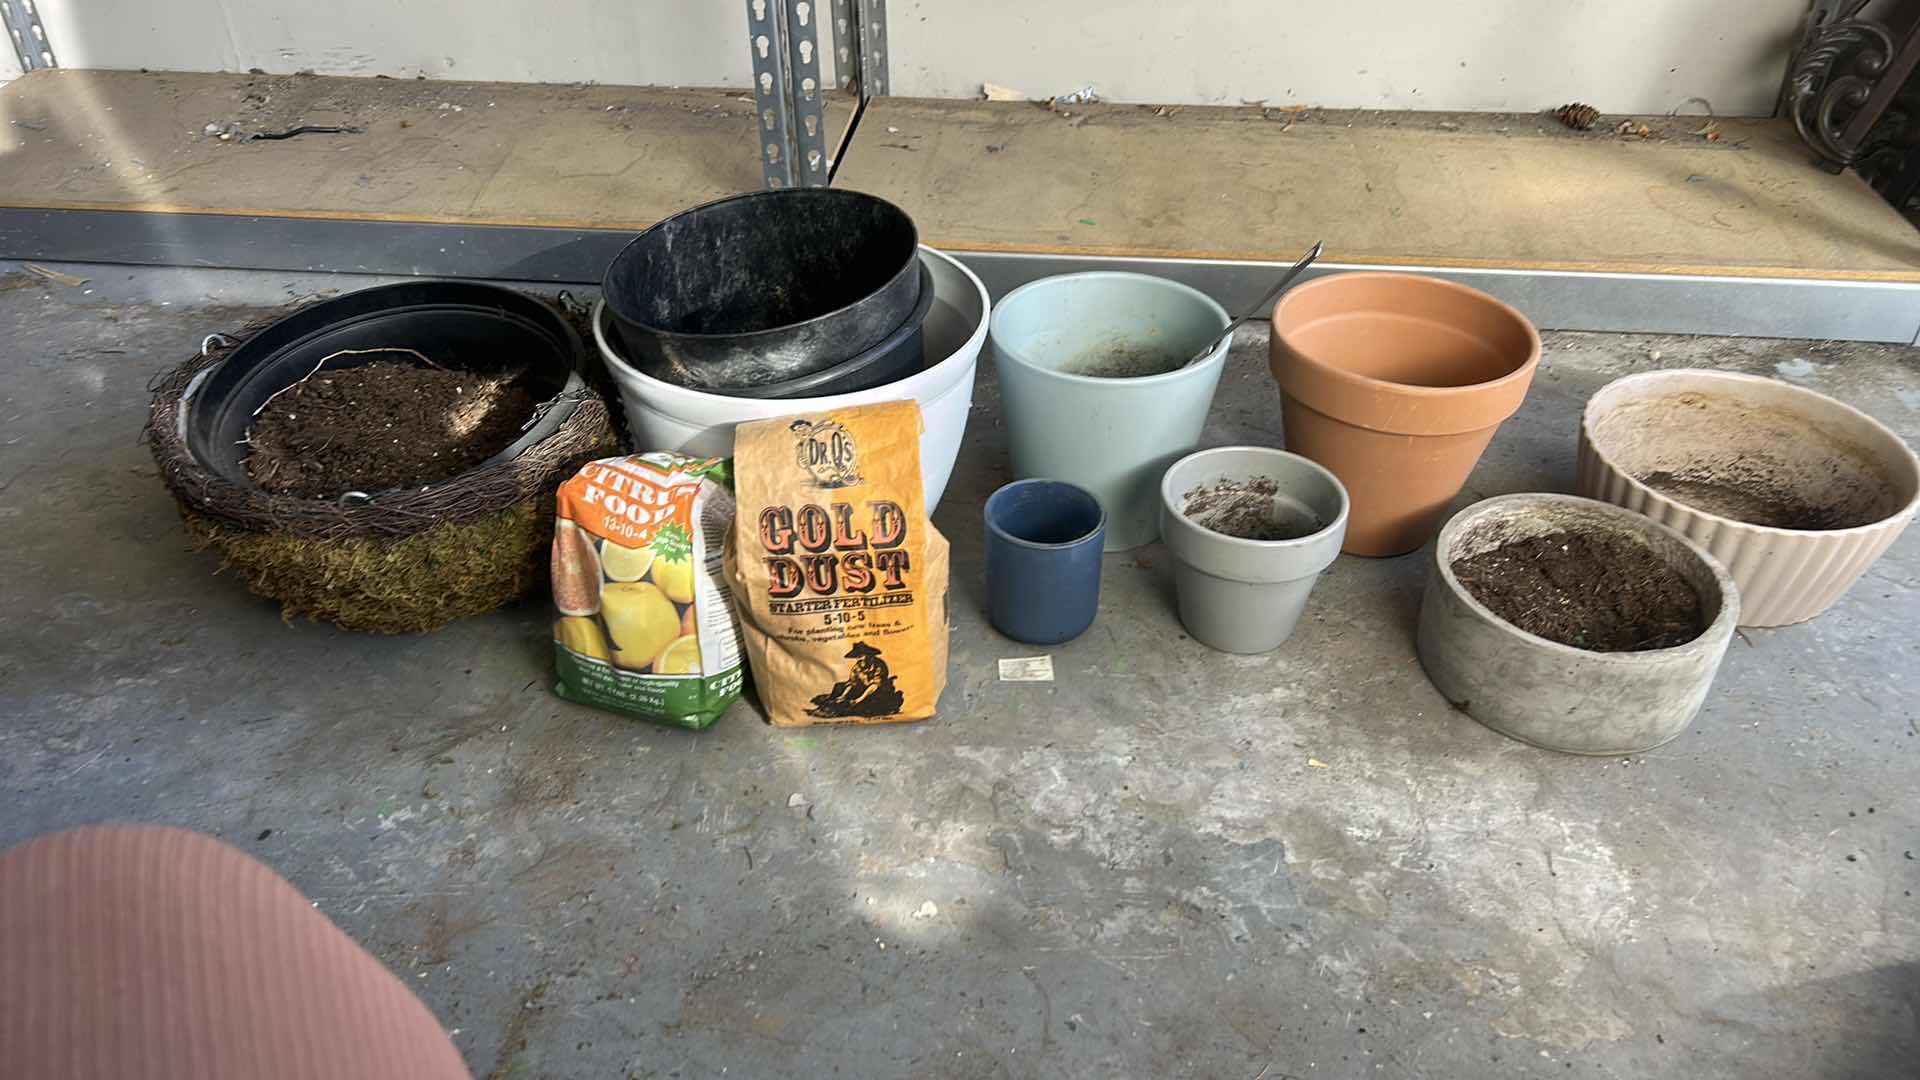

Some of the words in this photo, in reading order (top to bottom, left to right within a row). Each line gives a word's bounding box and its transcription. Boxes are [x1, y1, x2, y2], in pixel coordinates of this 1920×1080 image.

[582, 484, 676, 525] FOOD
[603, 516, 648, 540] 13-10-4
[759, 499, 907, 555] GOLD
[763, 548, 911, 598] DUST
[769, 600, 833, 614] STARTER
[834, 593, 914, 610] FERTILIZER
[824, 610, 866, 625] 5-10-5
